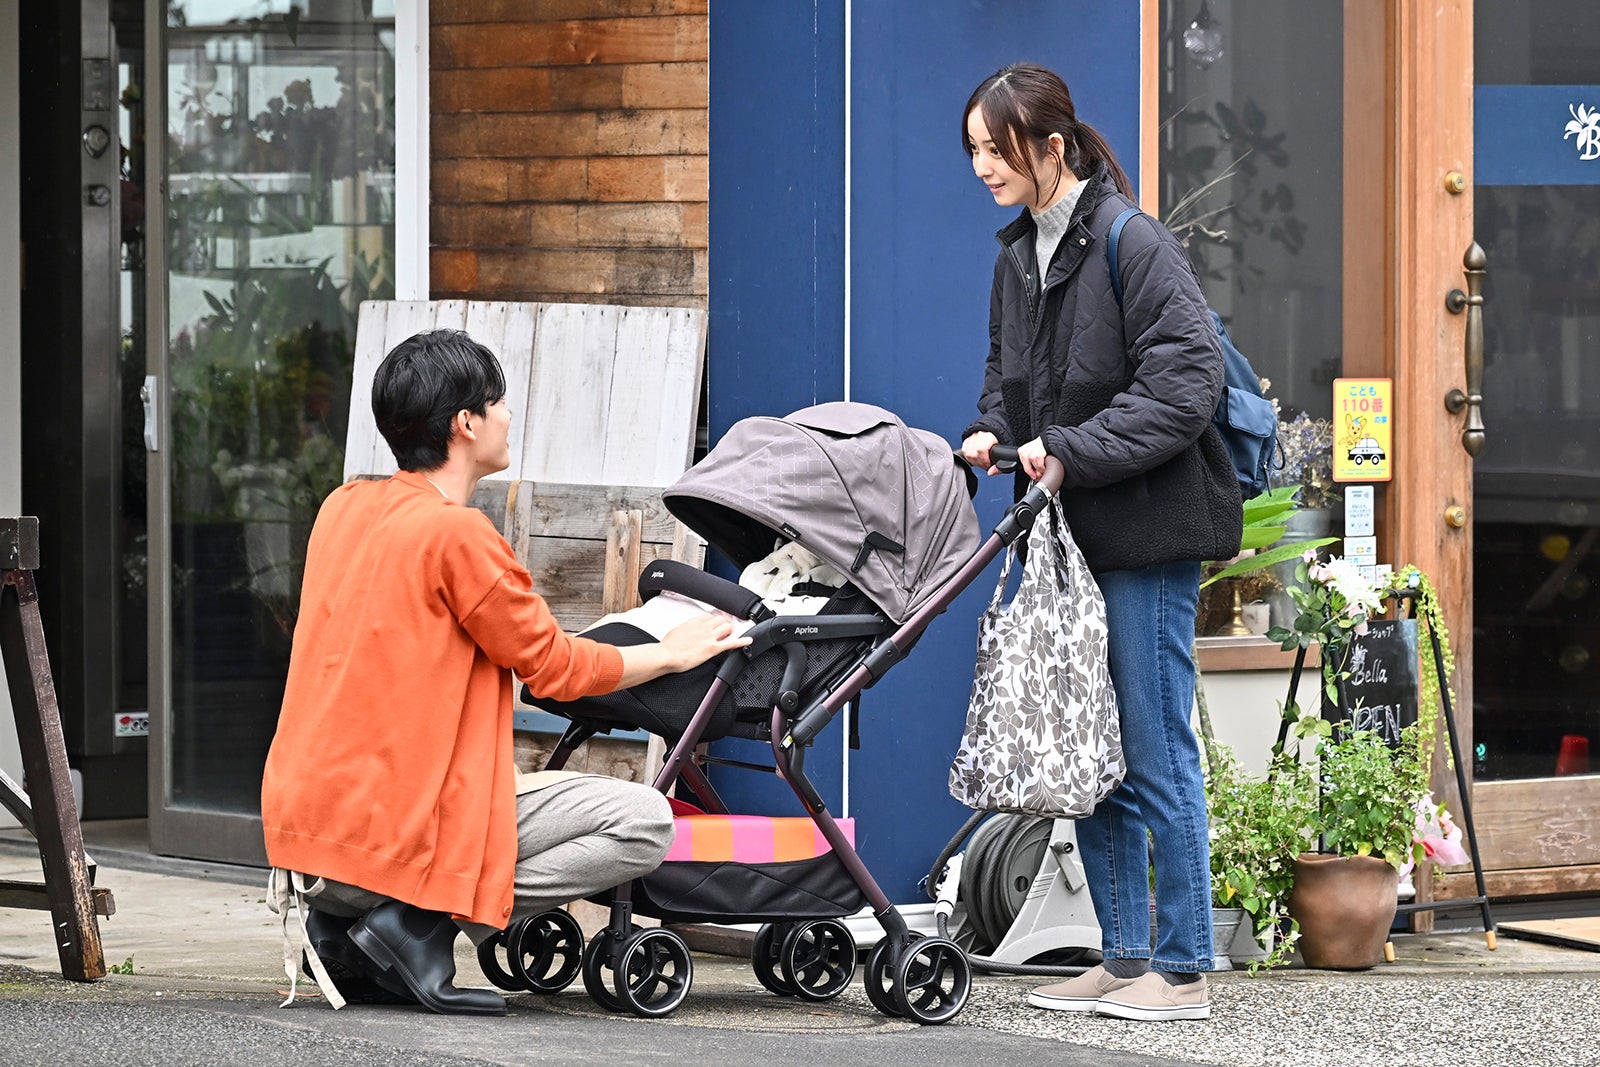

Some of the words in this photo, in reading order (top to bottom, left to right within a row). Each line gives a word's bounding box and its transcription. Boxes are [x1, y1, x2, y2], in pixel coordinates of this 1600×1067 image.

[1350, 386, 1377, 397] こども
[1342, 398, 1383, 413] 110番
[794, 626, 818, 635] Aprica
